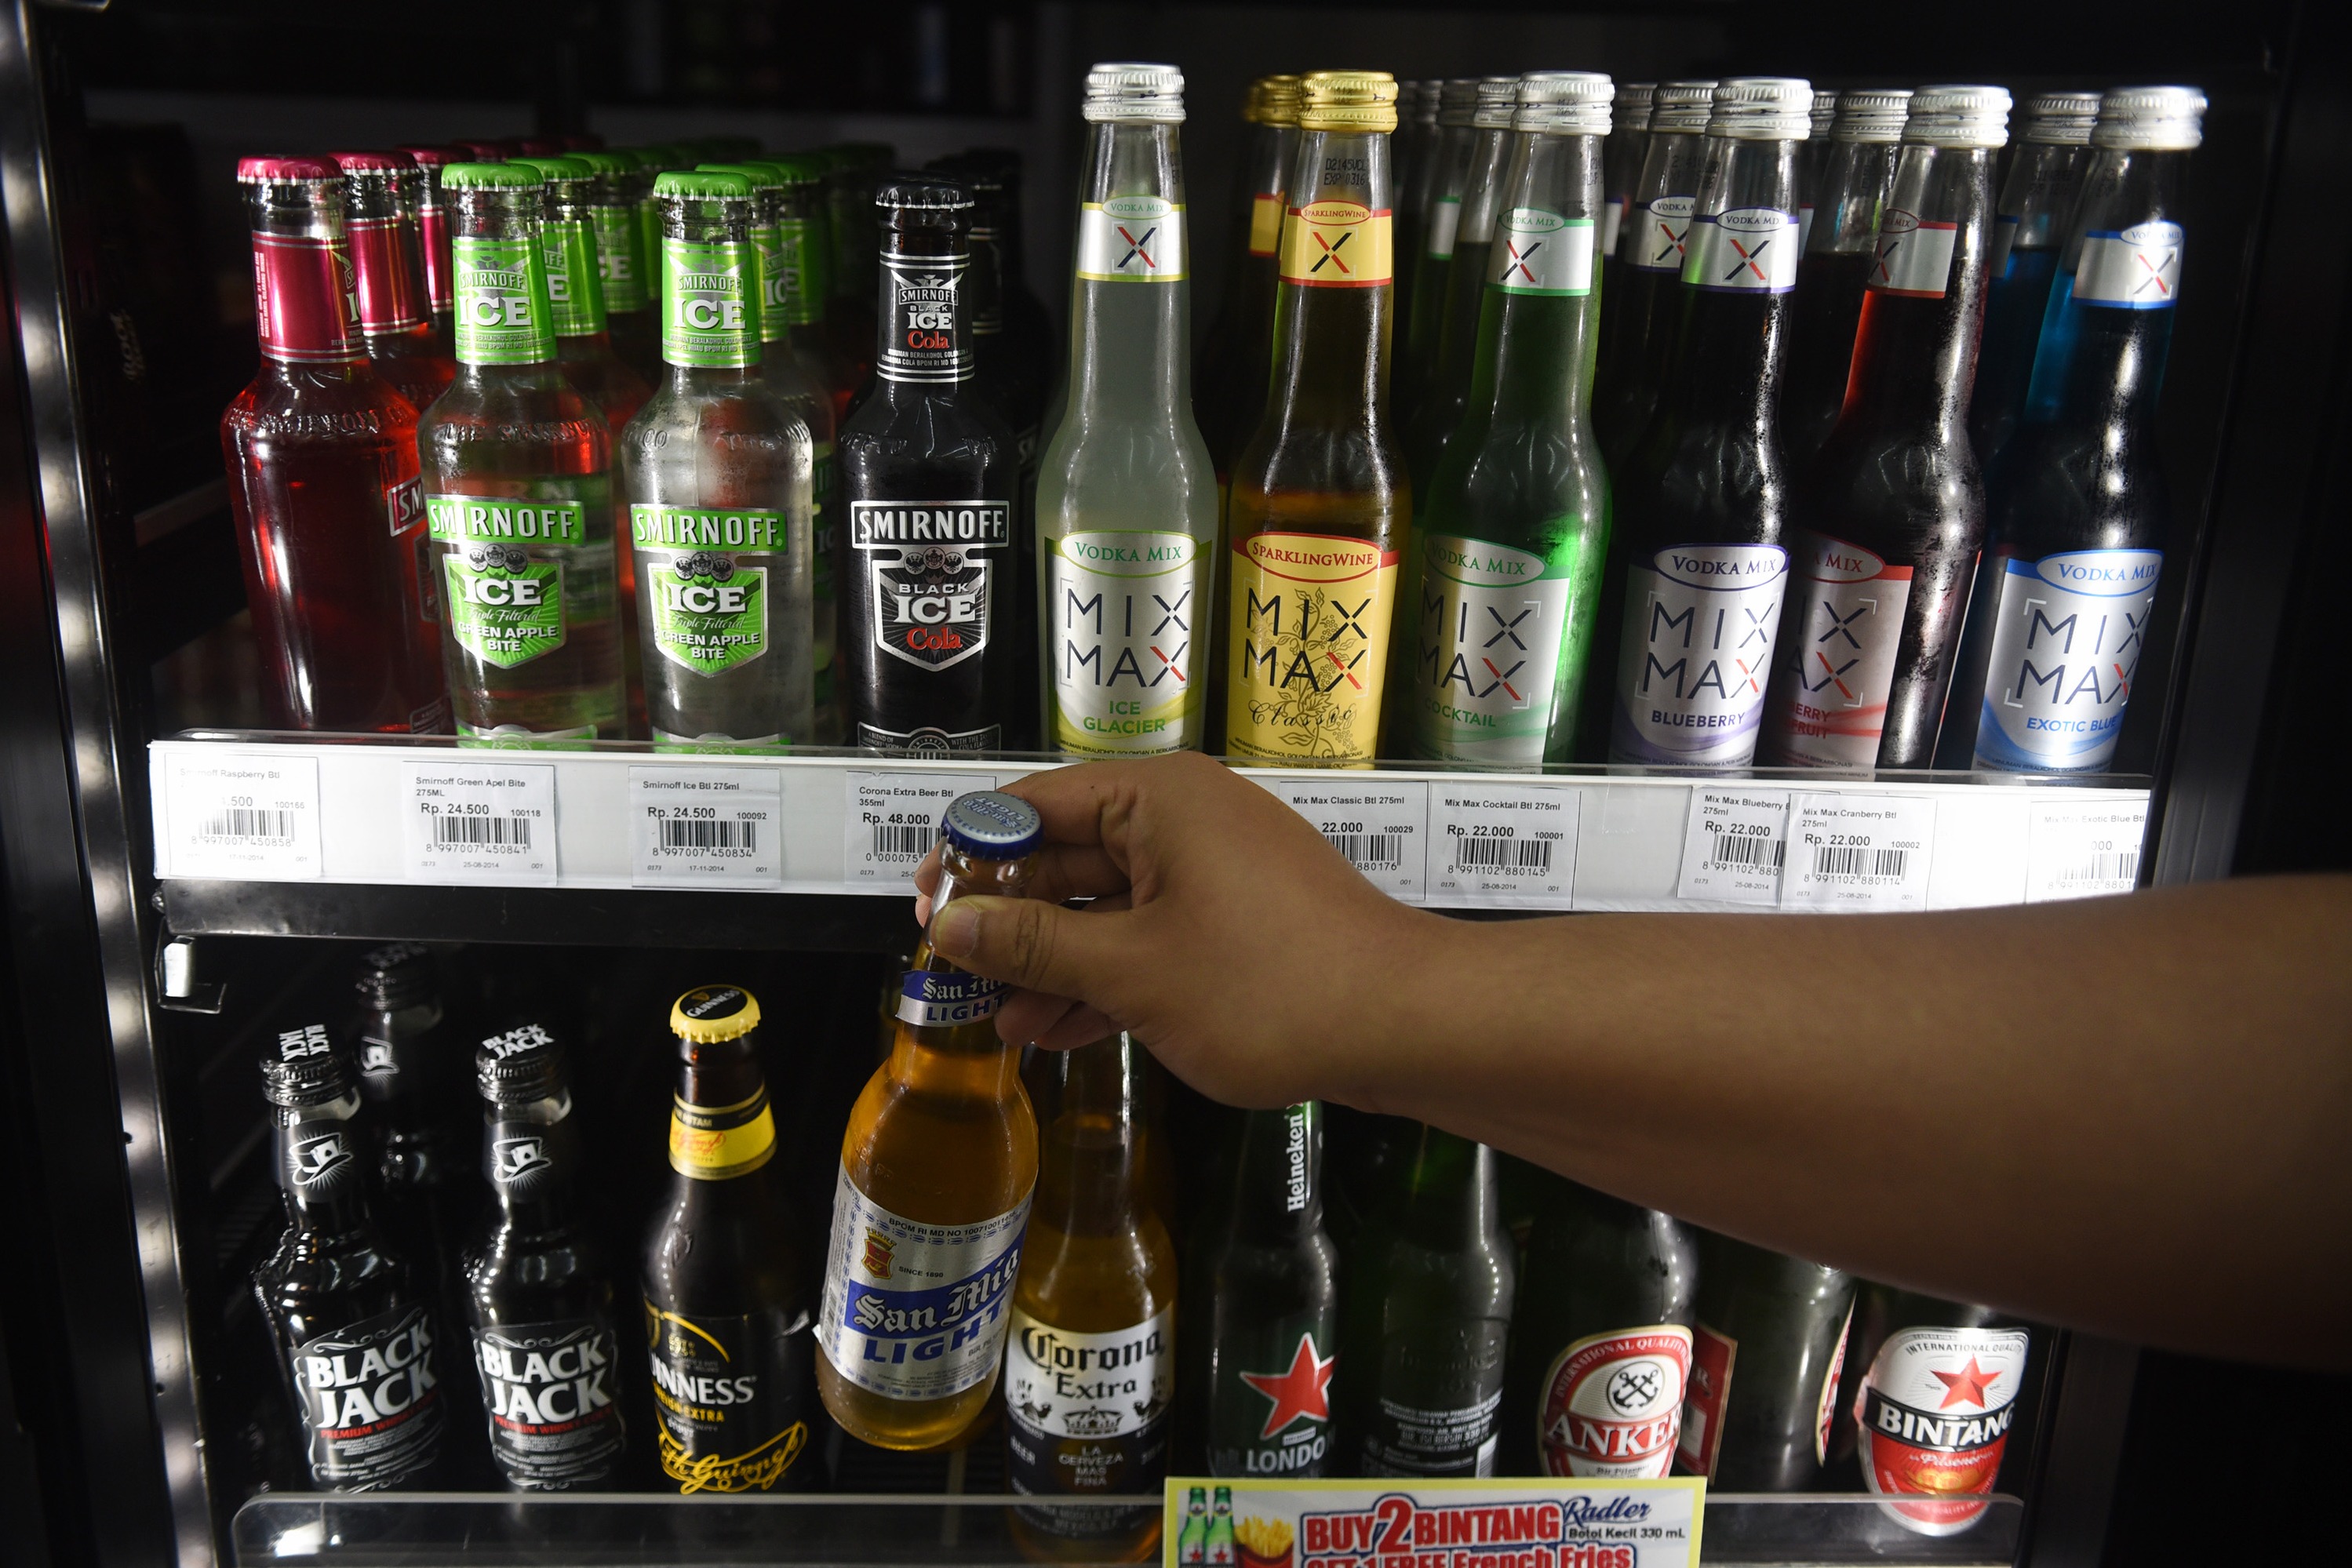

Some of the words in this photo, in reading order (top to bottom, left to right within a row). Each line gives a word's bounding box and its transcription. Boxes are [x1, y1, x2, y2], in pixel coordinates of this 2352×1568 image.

[1111, 202, 1144, 213] VODKA
[1147, 203, 1163, 213] MIX
[1658, 202, 1687, 212] VODKA
[1535, 216, 1556, 227] MIX
[1726, 216, 1759, 225] VODKA
[460, 273, 524, 289] SMIRNOFF
[679, 276, 741, 292] SMIRNOFF
[901, 289, 956, 304] SMIRNOFF
[458, 296, 532, 326] ICE
[672, 297, 745, 330] ICE
[908, 312, 952, 329] ICE
[908, 330, 950, 349] Cola
[430, 504, 574, 538] SMIRNOFF
[635, 513, 779, 546] SMIRNOFF
[859, 510, 1003, 540] SMIRNOFF
[1075, 541, 1140, 562] VODKA
[1147, 546, 1181, 561] MIX
[1253, 542, 1373, 566] SPARKLINGWINE
[1486, 558, 1526, 575] MIX
[1672, 555, 1740, 575] VODKA
[1826, 553, 1864, 573] MIX
[2058, 563, 2126, 581] VODKA
[462, 574, 542, 606] ICE
[667, 584, 746, 614] ICE
[898, 583, 970, 595] BLACK
[894, 593, 977, 624] ICE
[1067, 588, 1191, 637] MIX
[1247, 588, 1372, 642] MIX
[1422, 584, 1532, 651] MIX
[457, 621, 501, 638] GREEN
[504, 625, 559, 639] APPLE
[1650, 601, 1775, 649] MIX
[2027, 606, 2150, 655] MIX
[487, 639, 522, 652] BITE
[663, 631, 706, 646] GREEN
[710, 632, 760, 646] APPLE
[906, 627, 963, 650] Cola
[691, 647, 726, 659] BITE
[1067, 638, 1189, 687] MAX
[1243, 638, 1367, 693] MAX
[1418, 635, 1527, 700] MAX
[1643, 652, 1765, 700] MAX
[2016, 657, 2137, 704] MAX
[1109, 700, 1141, 715] ICE
[1248, 700, 1356, 726] Classic
[1425, 697, 1497, 728] COCKTAIL
[1083, 716, 1166, 734] GLACIER
[1651, 710, 1746, 728] BLUEBERRY
[2026, 717, 2086, 733] EXOTIC
[2089, 715, 2117, 732] BLUE
[220, 769, 265, 780] Raspberry
[486, 779, 506, 788] Apel
[643, 780, 681, 789] Smirnoff
[421, 803, 442, 816] Rp.
[447, 803, 490, 814] 24.500
[647, 807, 669, 820] Rp.
[674, 807, 715, 818] 24.500
[1483, 800, 1517, 809] Cocktail
[1703, 806, 1728, 816] 275ml
[1742, 799, 1782, 811] Blueberry
[1840, 809, 1882, 820] Cranberry
[863, 813, 883, 826] Rp.
[888, 814, 930, 824] 48.000
[1322, 822, 1363, 833] 22.000
[1473, 825, 1513, 837] 22.000
[1730, 824, 1770, 836] 22.000
[1830, 835, 1870, 846] 22.000
[1356, 862, 1397, 871] 880176
[922, 977, 963, 1000] San
[927, 993, 1007, 1021] LIGHT
[279, 1029, 308, 1061] JACK
[482, 1024, 546, 1050] BLACK
[493, 1031, 555, 1060] JACK
[1287, 1112, 1305, 1213] Heineken
[889, 1217, 916, 1233] BPOM
[898, 1266, 923, 1276] SINCE
[853, 1293, 936, 1333] San
[940, 1249, 1018, 1326] Mig
[863, 1299, 1006, 1364] LIGHT
[305, 1315, 431, 1388] BLACK
[1021, 1327, 1166, 1375] Corona
[1906, 1341, 1990, 1355] INTERNATIONAL
[1993, 1344, 2023, 1354] QUALITY
[480, 1334, 607, 1384] BLACK
[1556, 1340, 1635, 1398] INTERNATIONAL
[315, 1347, 437, 1429] JACK
[491, 1366, 612, 1424] JACK
[1056, 1372, 1136, 1400] Extra
[684, 1405, 725, 1422] EXTRA
[1877, 1401, 2015, 1446] BINTANG
[320, 1425, 373, 1439] PREMIUM
[1546, 1402, 1680, 1457] ANKER
[1059, 1453, 1123, 1464] CERVEZA
[1246, 1435, 1325, 1472] LONDO
[1306, 1515, 1374, 1553] BUY
[1378, 1500, 1412, 1554] 2
[1414, 1504, 1560, 1546] BINTANG
[1564, 1496, 1651, 1527] Radler
[1569, 1528, 1604, 1540] Botol
[1606, 1528, 1637, 1539] Kecil
[1640, 1529, 1662, 1539] 330
